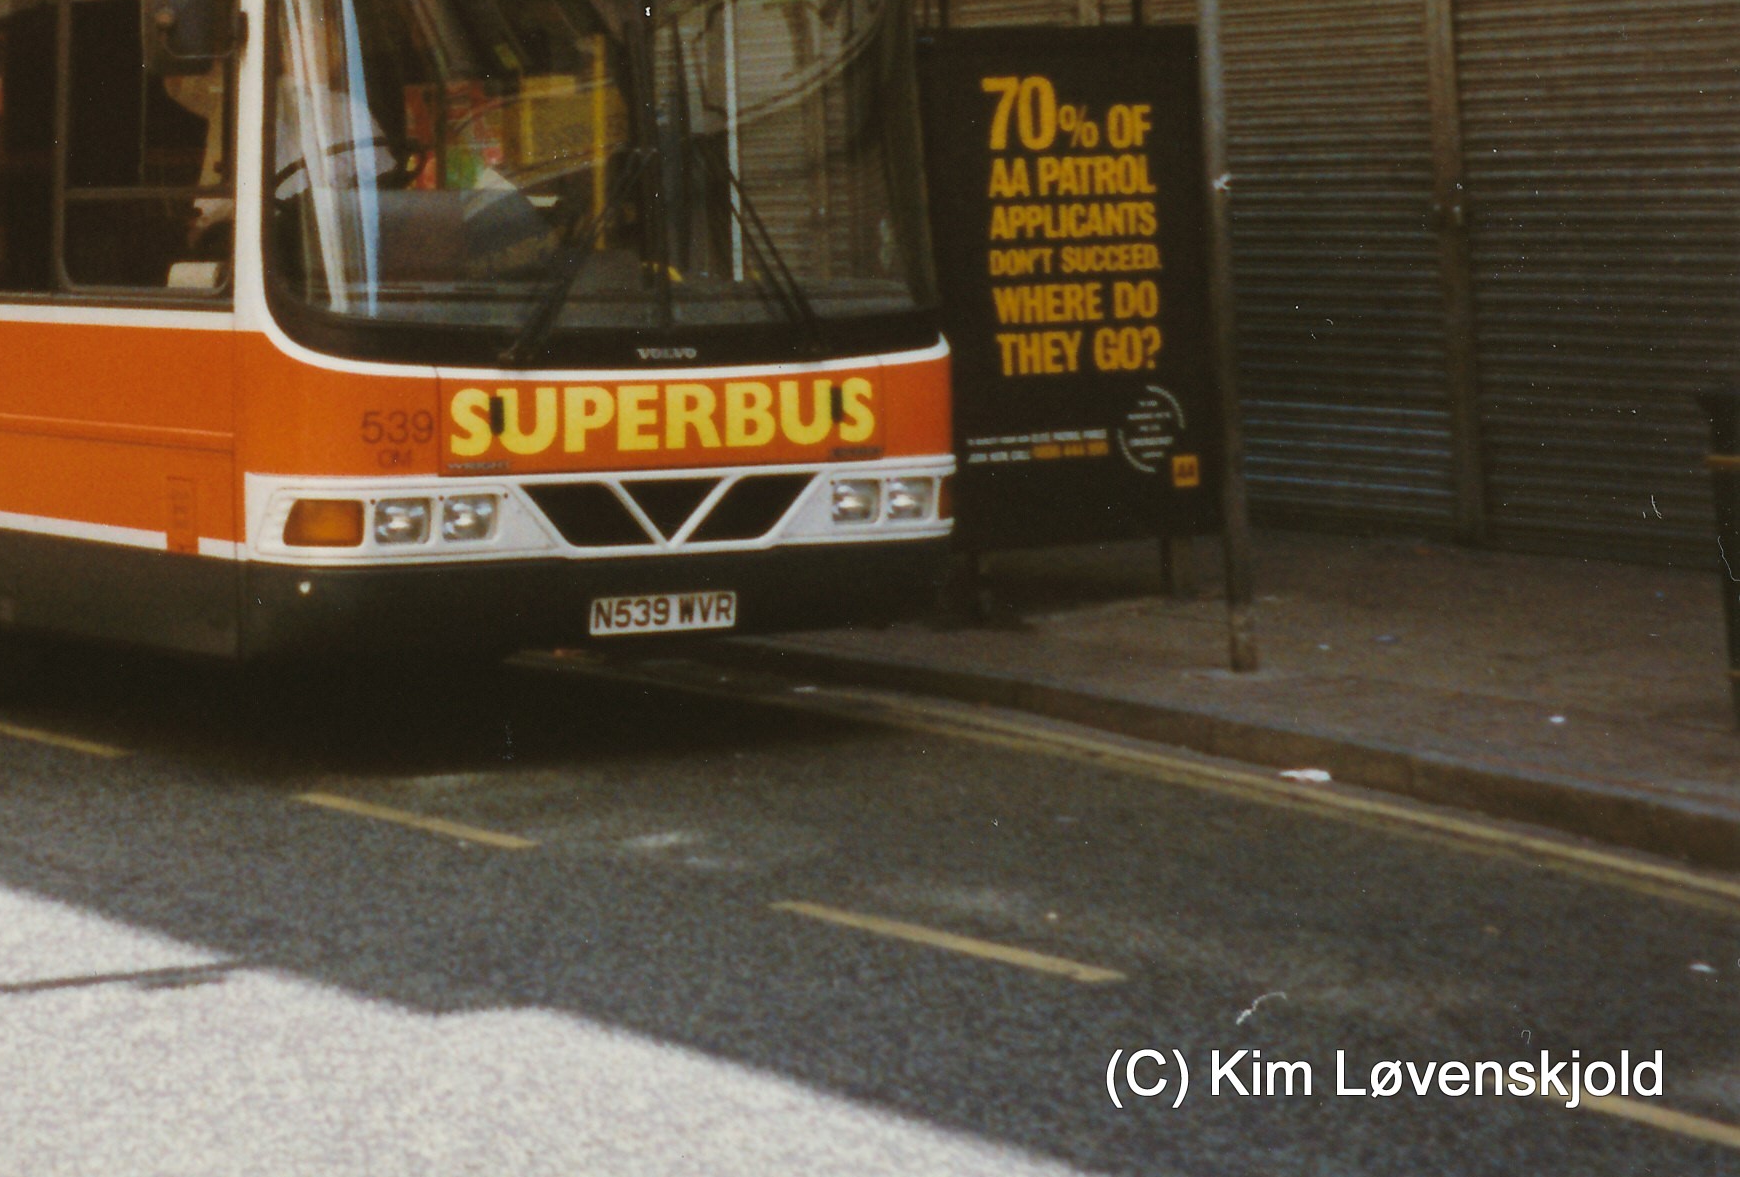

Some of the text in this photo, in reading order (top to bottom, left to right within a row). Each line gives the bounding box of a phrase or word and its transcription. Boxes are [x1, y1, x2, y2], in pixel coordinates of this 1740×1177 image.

[981, 76, 1152, 151] 70% OF
[989, 153, 1157, 198] AA PATROL
[990, 201, 1157, 240] APPLICANTS
[989, 248, 1053, 276] DON'T
[992, 280, 1158, 324] WHERE DO
[636, 347, 698, 360] VOLVO
[996, 326, 1161, 376] THEY GO?
[361, 409, 434, 444] 539
[450, 376, 876, 457] SUPERBUS
[594, 593, 733, 628] N539 WVR
